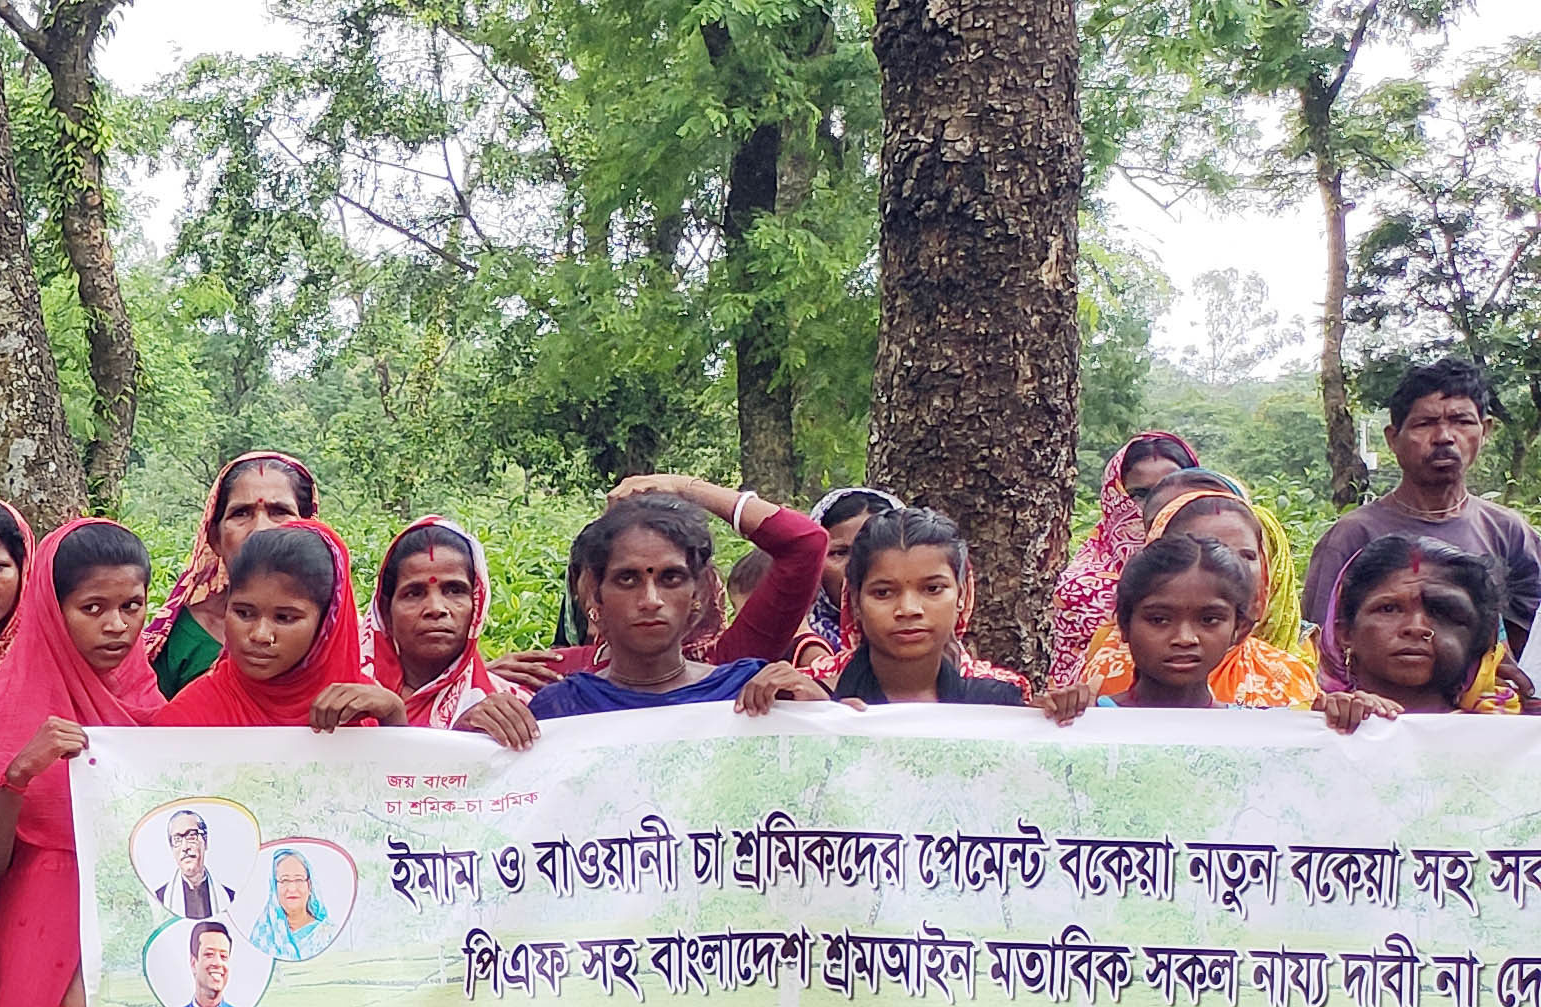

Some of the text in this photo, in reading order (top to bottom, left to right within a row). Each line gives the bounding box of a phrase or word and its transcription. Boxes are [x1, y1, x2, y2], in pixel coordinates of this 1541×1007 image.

[387, 840, 477, 908] ইমাম
[493, 847, 525, 897] ও
[533, 815, 682, 894] বাওয়ানী
[687, 832, 722, 888] চা
[733, 811, 902, 892] শ্রমিকদের
[915, 818, 1045, 899] পেমেন্ট
[1056, 839, 1174, 900] বকেয়া
[1186, 843, 1283, 916] নতুন
[1289, 846, 1403, 907] বকেয়া
[1413, 850, 1473, 913] সহ
[462, 928, 565, 998] পিএফ
[579, 939, 638, 998] সহ
[647, 927, 810, 992] বাংলাদেশ
[821, 921, 973, 998] শ্রমআইন
[1143, 947, 1237, 1004] সকল
